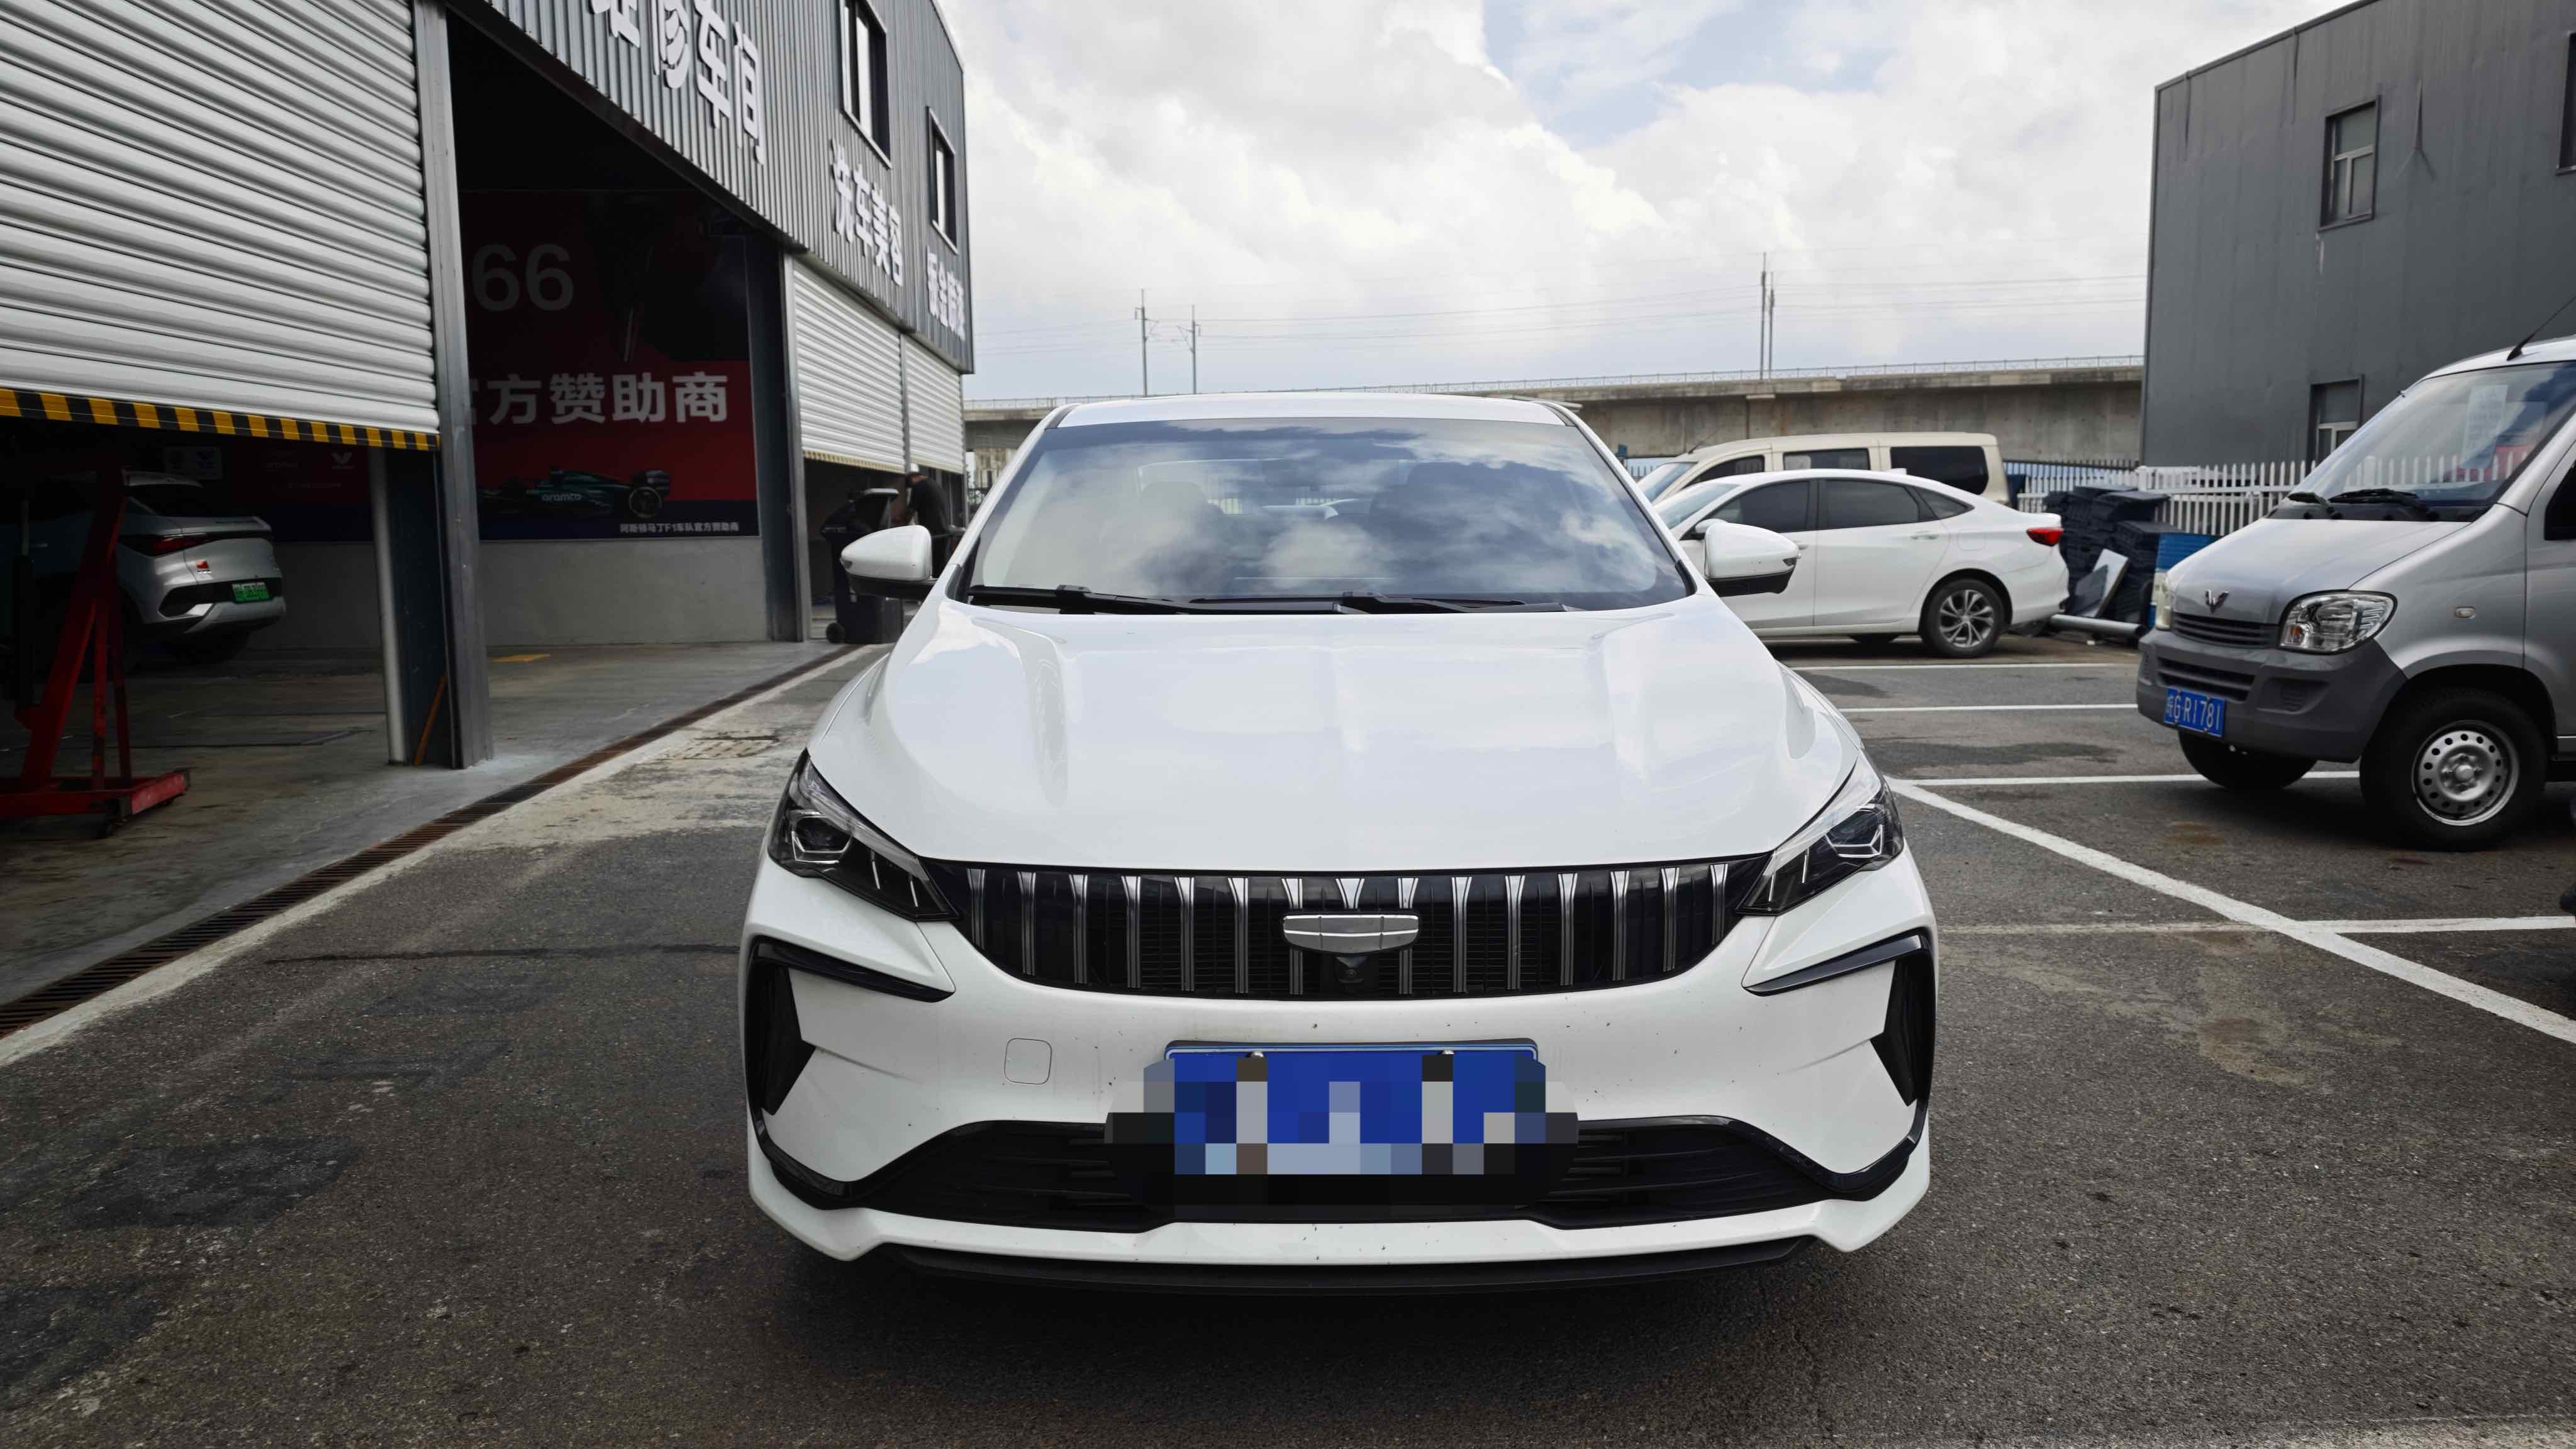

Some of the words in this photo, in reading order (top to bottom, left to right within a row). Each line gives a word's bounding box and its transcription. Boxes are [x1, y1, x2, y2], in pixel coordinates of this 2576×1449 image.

[830, 138, 903, 287] 洗车美容
[472, 243, 574, 312] 66
[470, 370, 728, 425] 方赞助商
